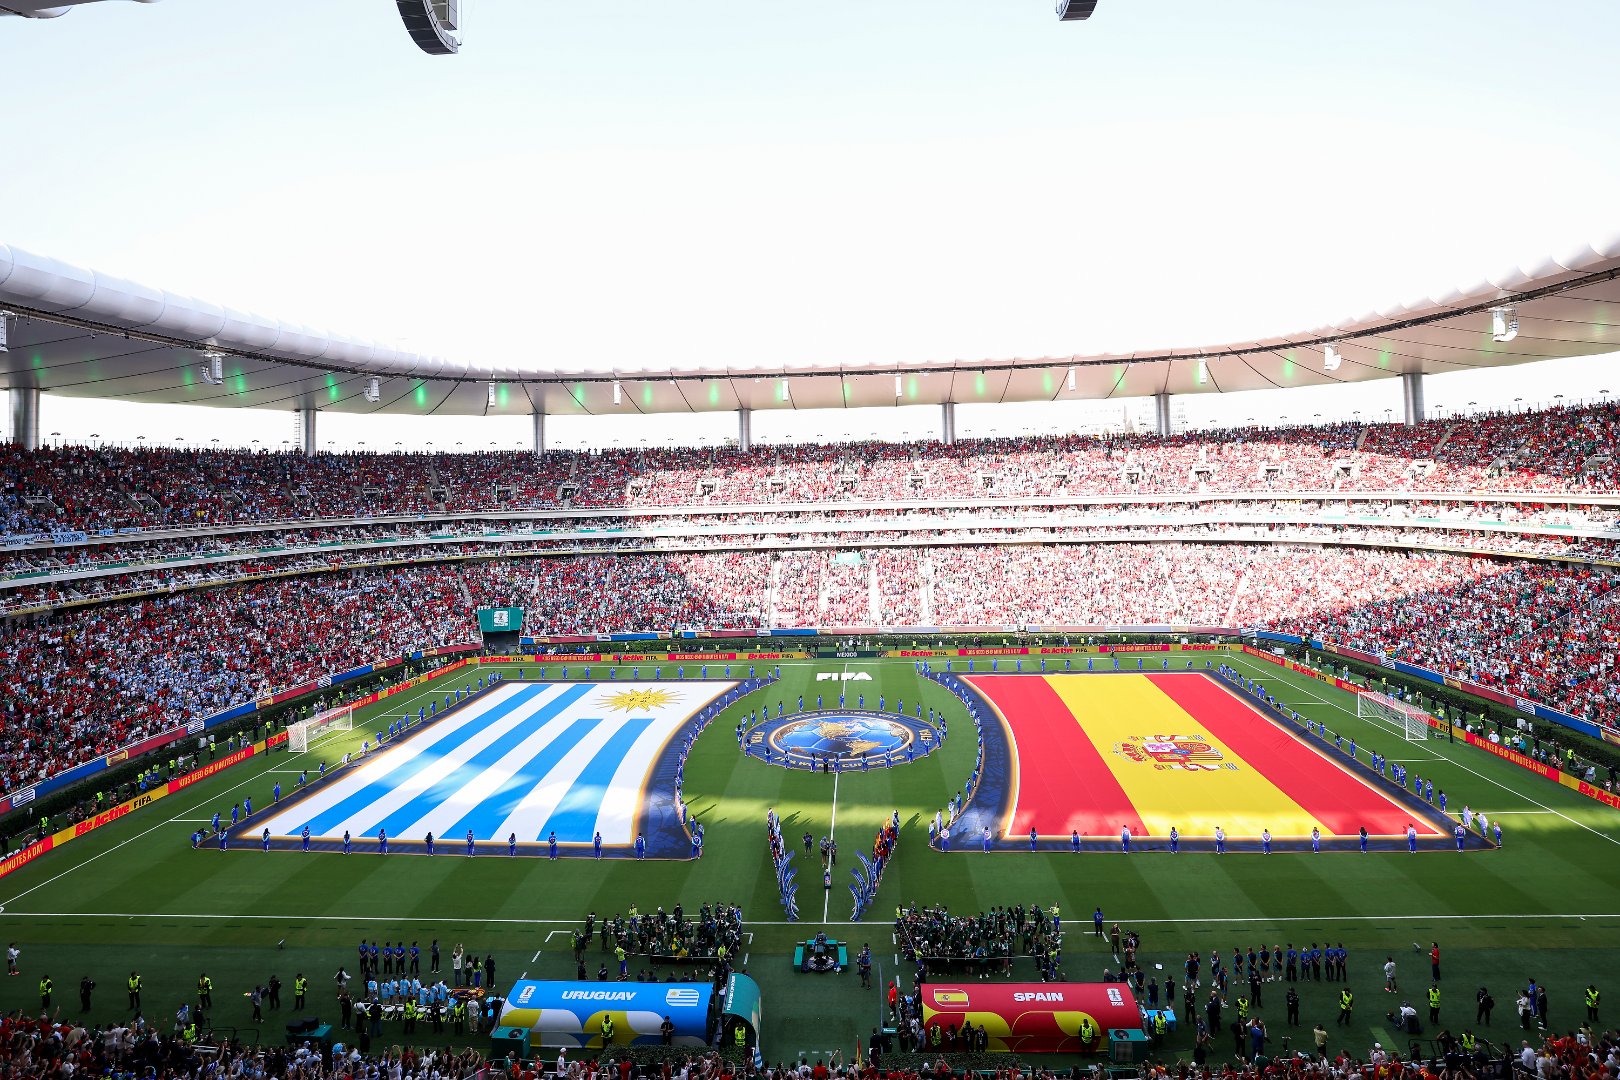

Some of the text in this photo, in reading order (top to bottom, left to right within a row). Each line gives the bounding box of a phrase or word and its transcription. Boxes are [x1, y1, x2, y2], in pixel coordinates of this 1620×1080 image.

[816, 672, 872, 681] FIFA
[1475, 737, 1485, 748] KIDS
[1486, 741, 1498, 753] NEED
[1499, 748, 1509, 758] 60
[1533, 762, 1536, 770] A
[1538, 764, 1548, 775] DAY
[1579, 781, 1595, 797] Be
[75, 795, 152, 836] Be Active FIFA
[28, 850, 31, 860] A
[32, 843, 44, 856] DAY
[562, 990, 637, 1001] URUGUAY
[1013, 992, 1064, 1002] SPAIN
